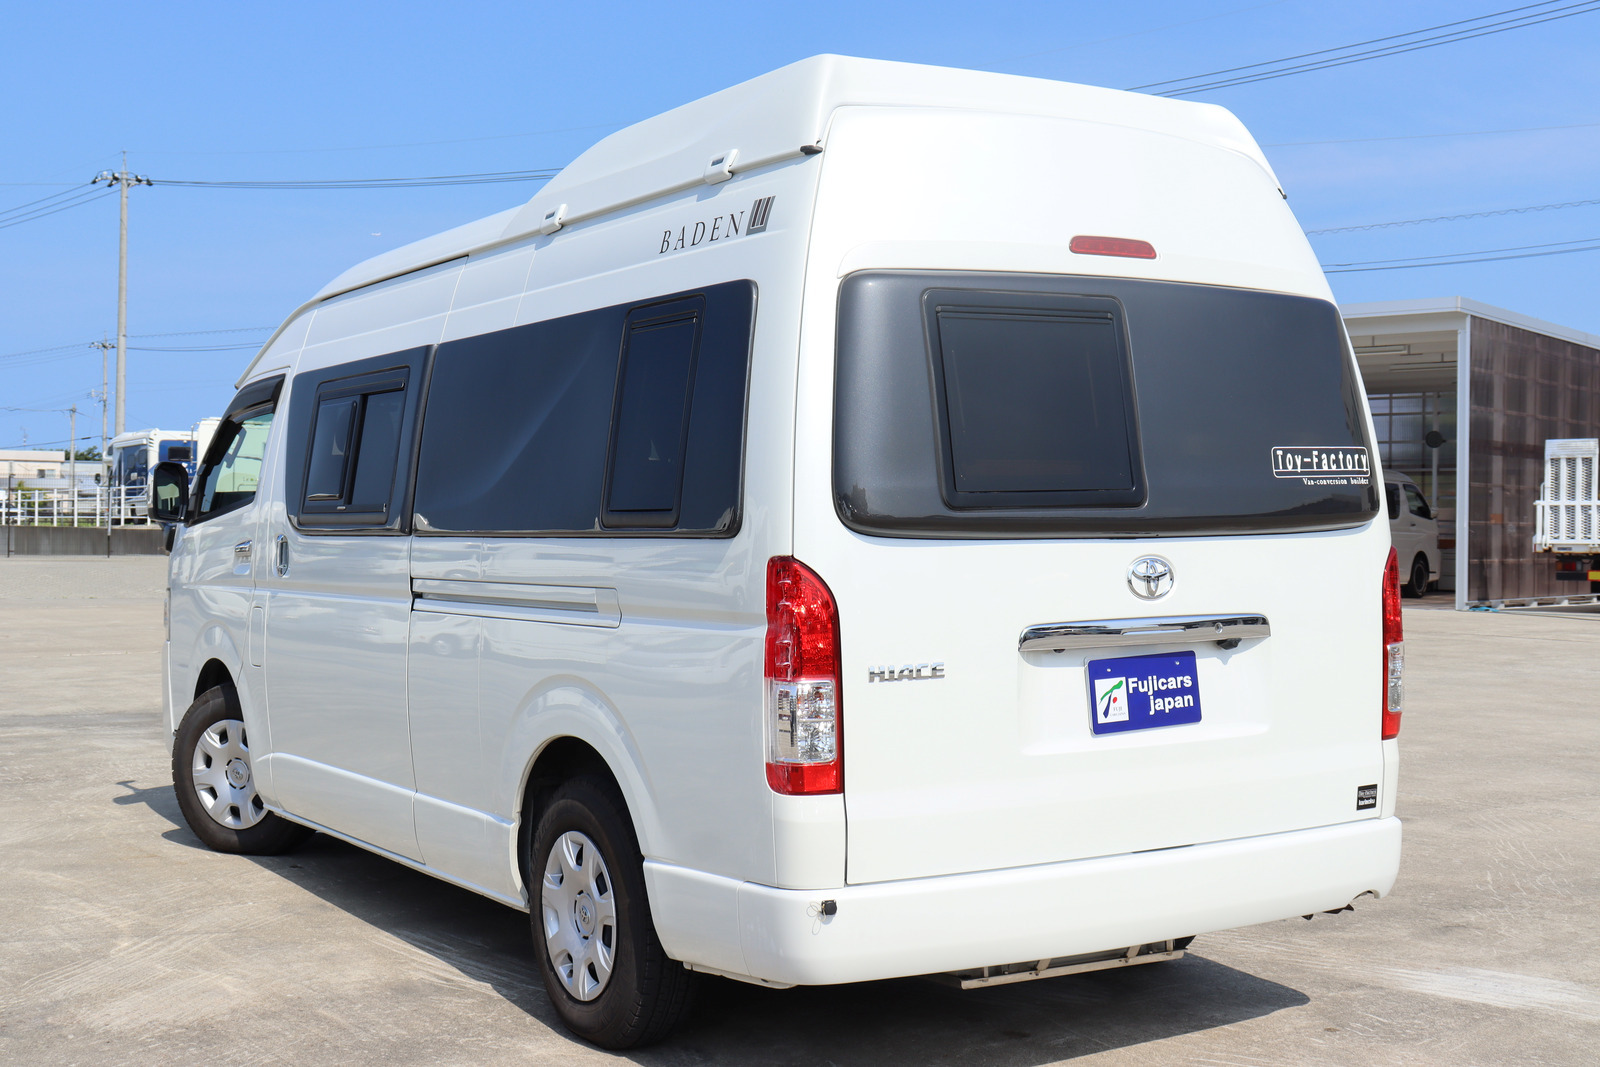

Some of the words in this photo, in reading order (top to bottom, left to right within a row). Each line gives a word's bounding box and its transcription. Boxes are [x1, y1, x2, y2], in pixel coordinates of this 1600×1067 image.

[658, 210, 745, 254] BADEN
[1276, 450, 1367, 472] Toy-Factory
[868, 662, 945, 683] HIACE
[1127, 675, 1192, 695] Fujicars
[1149, 694, 1194, 715] japan
